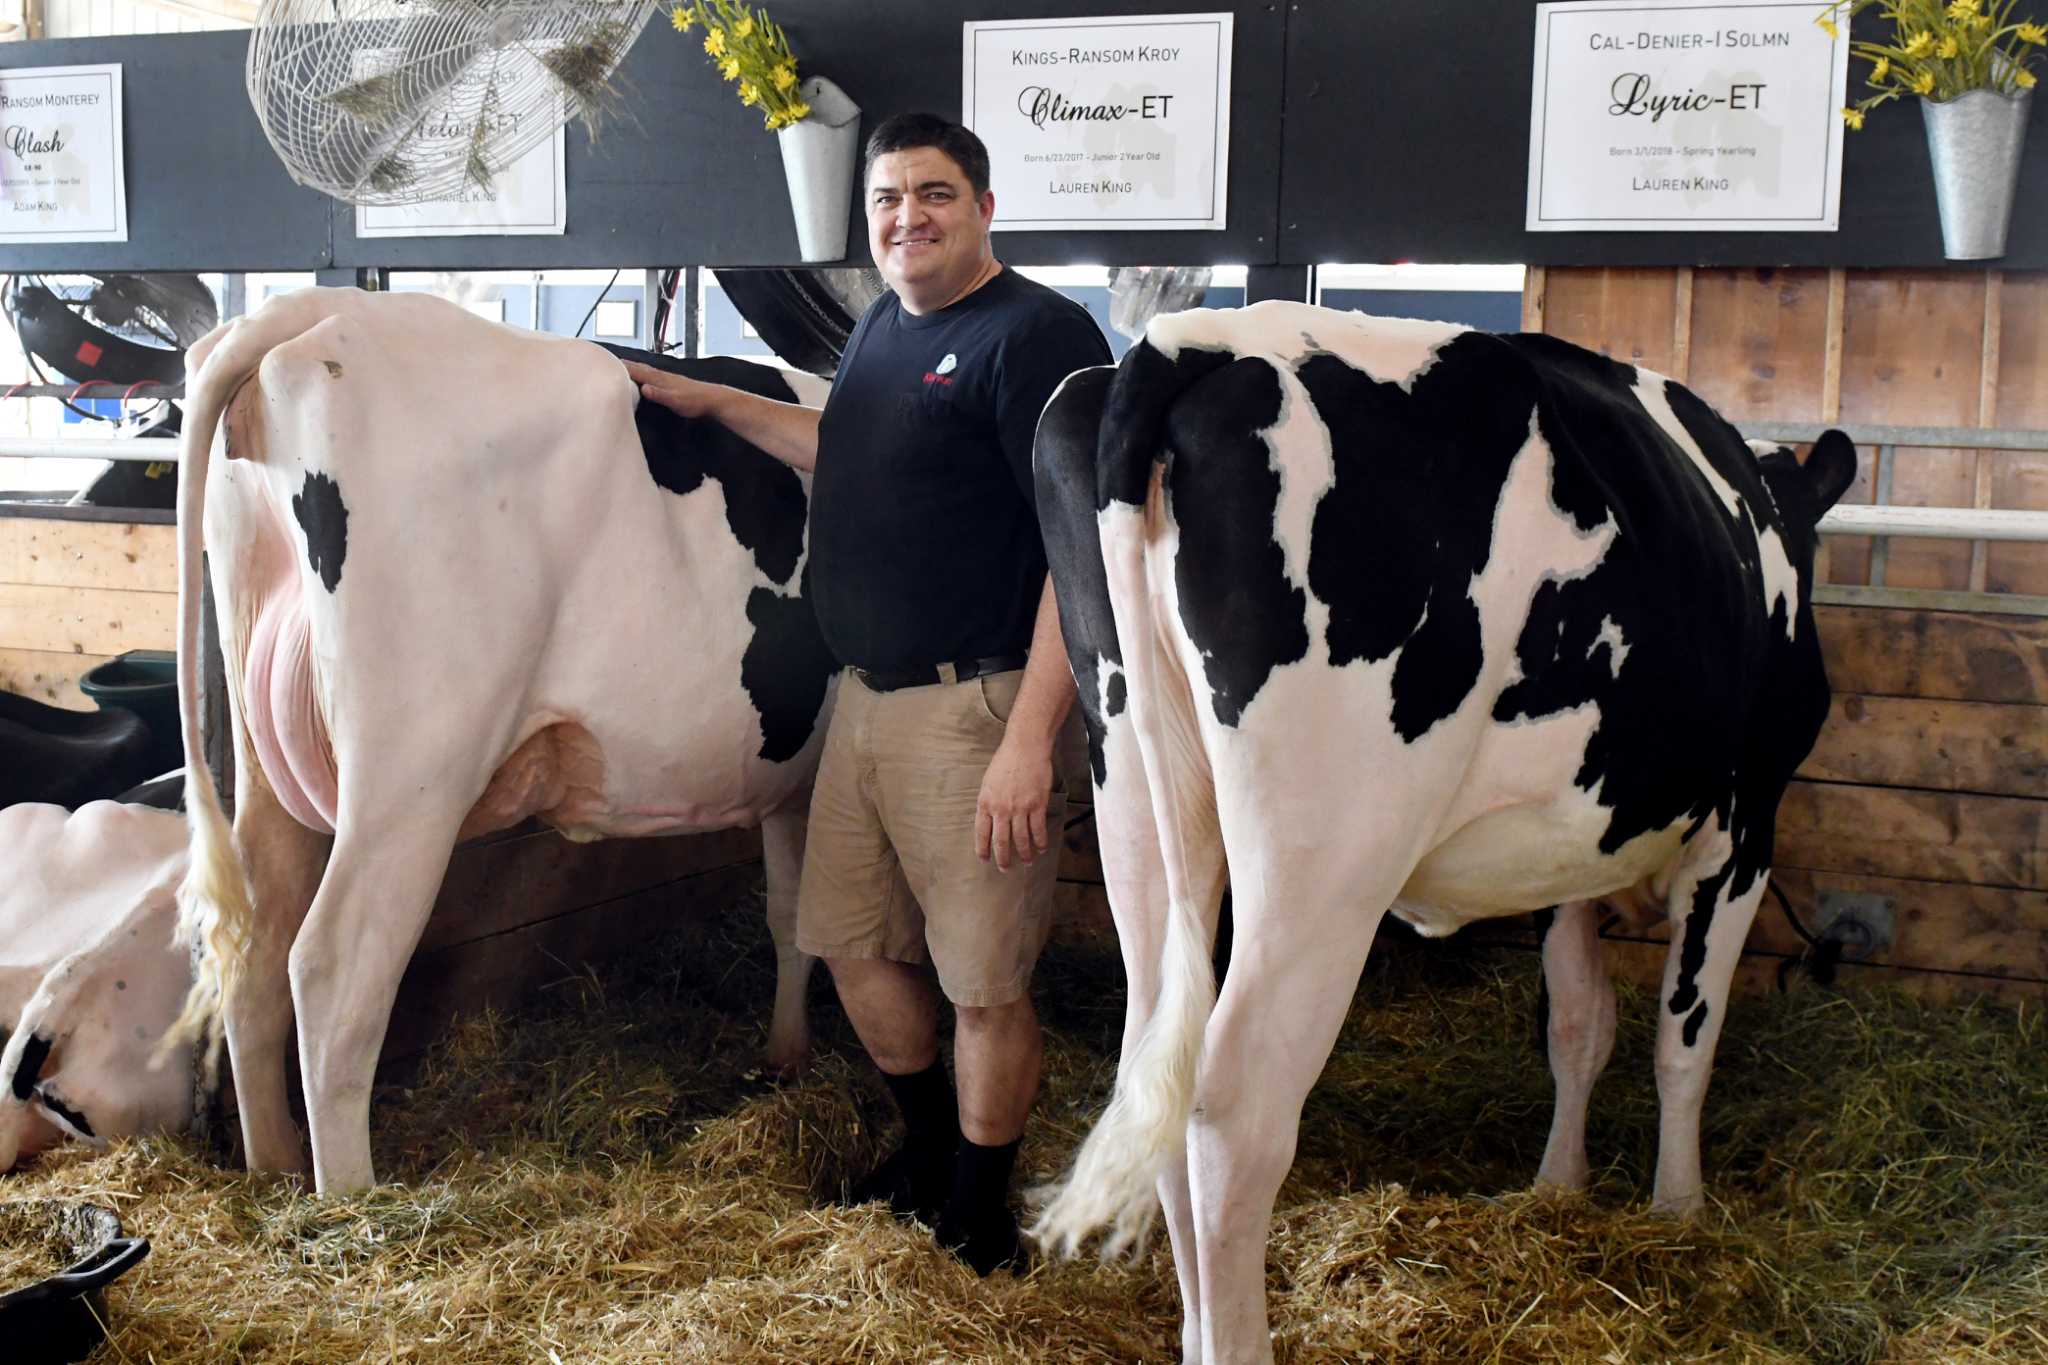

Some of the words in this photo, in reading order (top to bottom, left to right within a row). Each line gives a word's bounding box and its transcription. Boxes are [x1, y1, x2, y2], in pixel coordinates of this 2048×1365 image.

[1725, 30, 1790, 48] SOLMN
[1012, 48, 1134, 65] KINGS-RANSOM
[1138, 46, 1181, 62] KROY
[45, 93, 100, 107] MONTEREY
[1608, 72, 1767, 123] Lyric-ET
[1018, 86, 1174, 131] Climax-ET
[4, 125, 65, 160] Clash
[1024, 153, 1044, 162] Born
[1126, 152, 1144, 161] Year
[1146, 151, 1161, 161] Old
[1682, 146, 1715, 158] Spring
[1049, 181, 1099, 194] LAUREN
[1102, 180, 1132, 193] KING
[1632, 176, 1690, 191] LAUREN
[1694, 176, 1730, 191] KING
